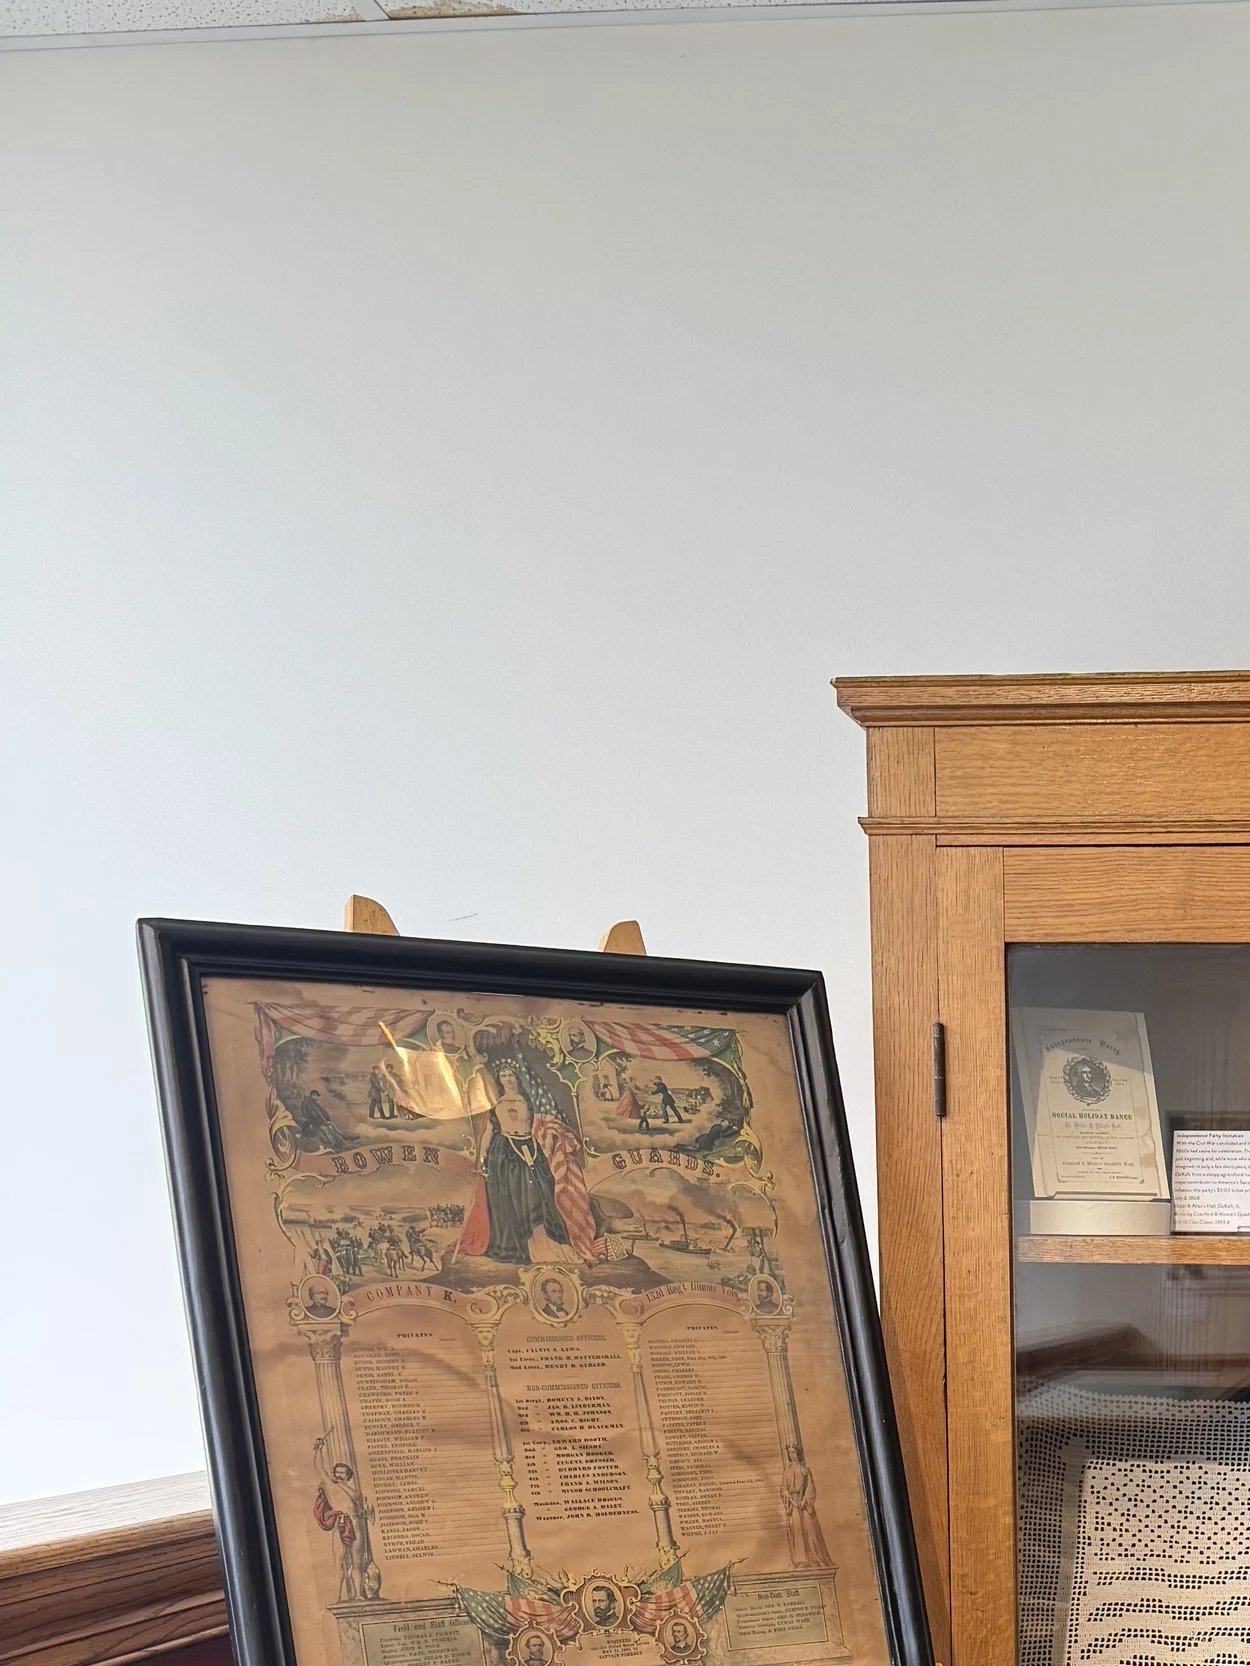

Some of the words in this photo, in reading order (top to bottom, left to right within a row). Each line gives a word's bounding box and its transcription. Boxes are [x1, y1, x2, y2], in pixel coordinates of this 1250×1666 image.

[1078, 1112, 1108, 1120] HOLIDAY
[332, 1146, 440, 1174] BOWEN
[612, 1148, 720, 1176] GUARDS.
[366, 1285, 433, 1302] COMPANY
[443, 1290, 457, 1304] K.
